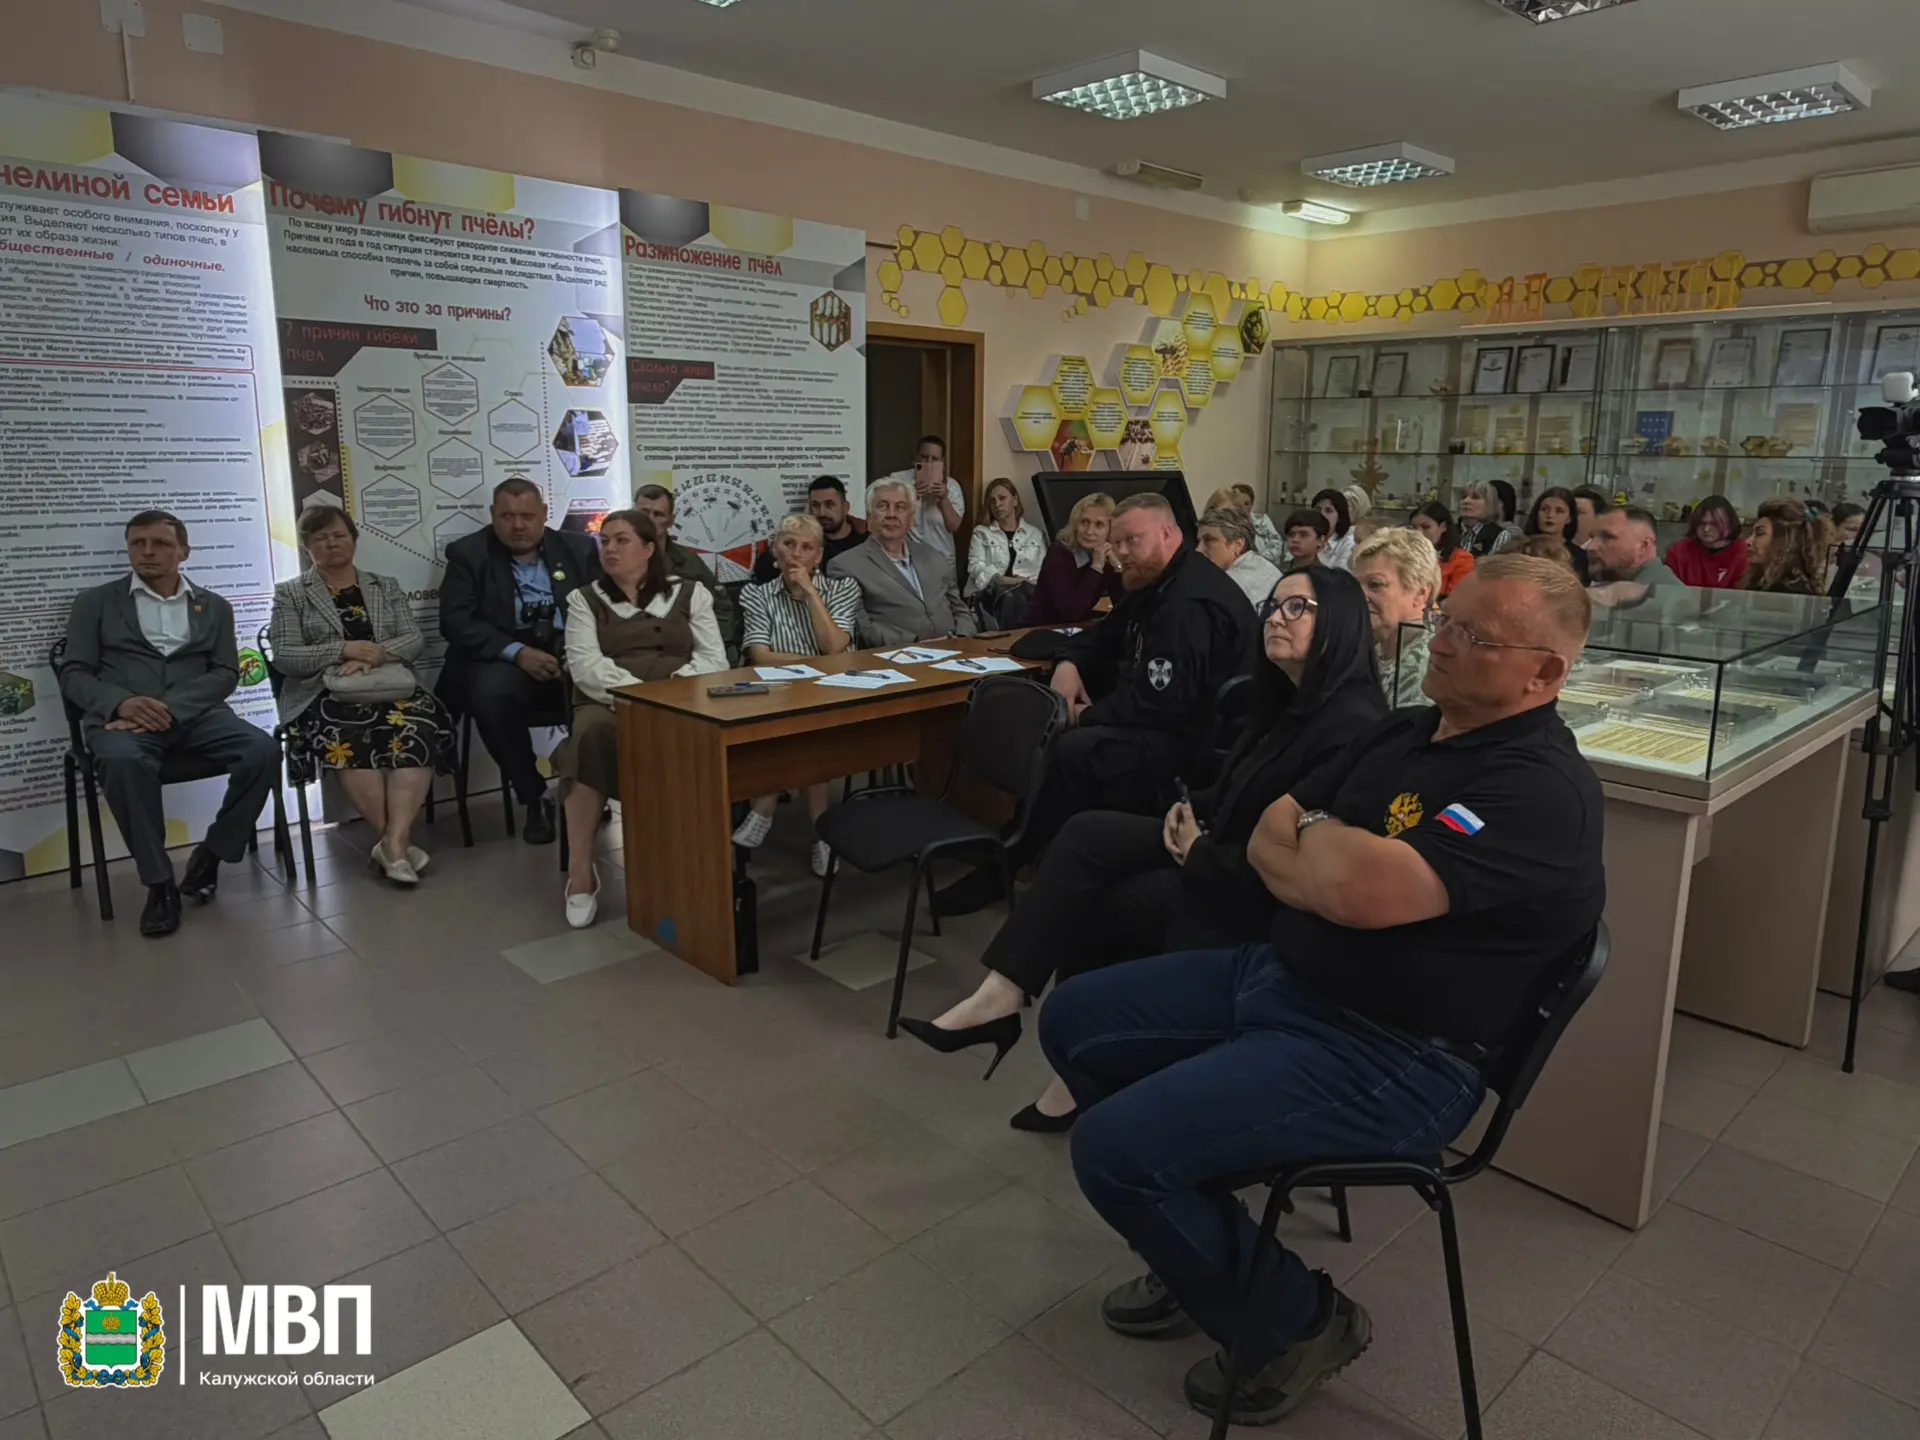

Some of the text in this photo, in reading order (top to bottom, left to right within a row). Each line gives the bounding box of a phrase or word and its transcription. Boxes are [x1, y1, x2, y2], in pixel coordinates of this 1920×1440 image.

[144, 183, 235, 214] семьи
[269, 181, 535, 241] Почему гибнут пчёлы?
[24, 215, 88, 231] Выделяют
[92, 226, 151, 240] несколько
[154, 231, 186, 242] типов
[63, 207, 111, 222] особого
[114, 215, 173, 230] внимания,
[176, 222, 230, 237] поскольку
[288, 217, 302, 228] По
[304, 222, 333, 234] всему
[335, 226, 358, 237] миру
[360, 228, 406, 241] пасечники
[408, 233, 455, 248] фиксируют
[457, 240, 499, 252] рекордное
[17, 229, 32, 237] их
[35, 230, 79, 243] образа
[284, 230, 320, 243] Причем
[336, 237, 356, 248] года
[366, 240, 381, 251] год
[143, 254, 226, 271] одиночные.
[286, 245, 338, 258] насекомых
[434, 260, 459, 271] собой
[624, 236, 783, 276] Размножение пчёл
[364, 294, 512, 322] Что это за причины?
[302, 325, 360, 342] причин
[367, 328, 419, 344] гибели
[286, 348, 325, 362] пчел
